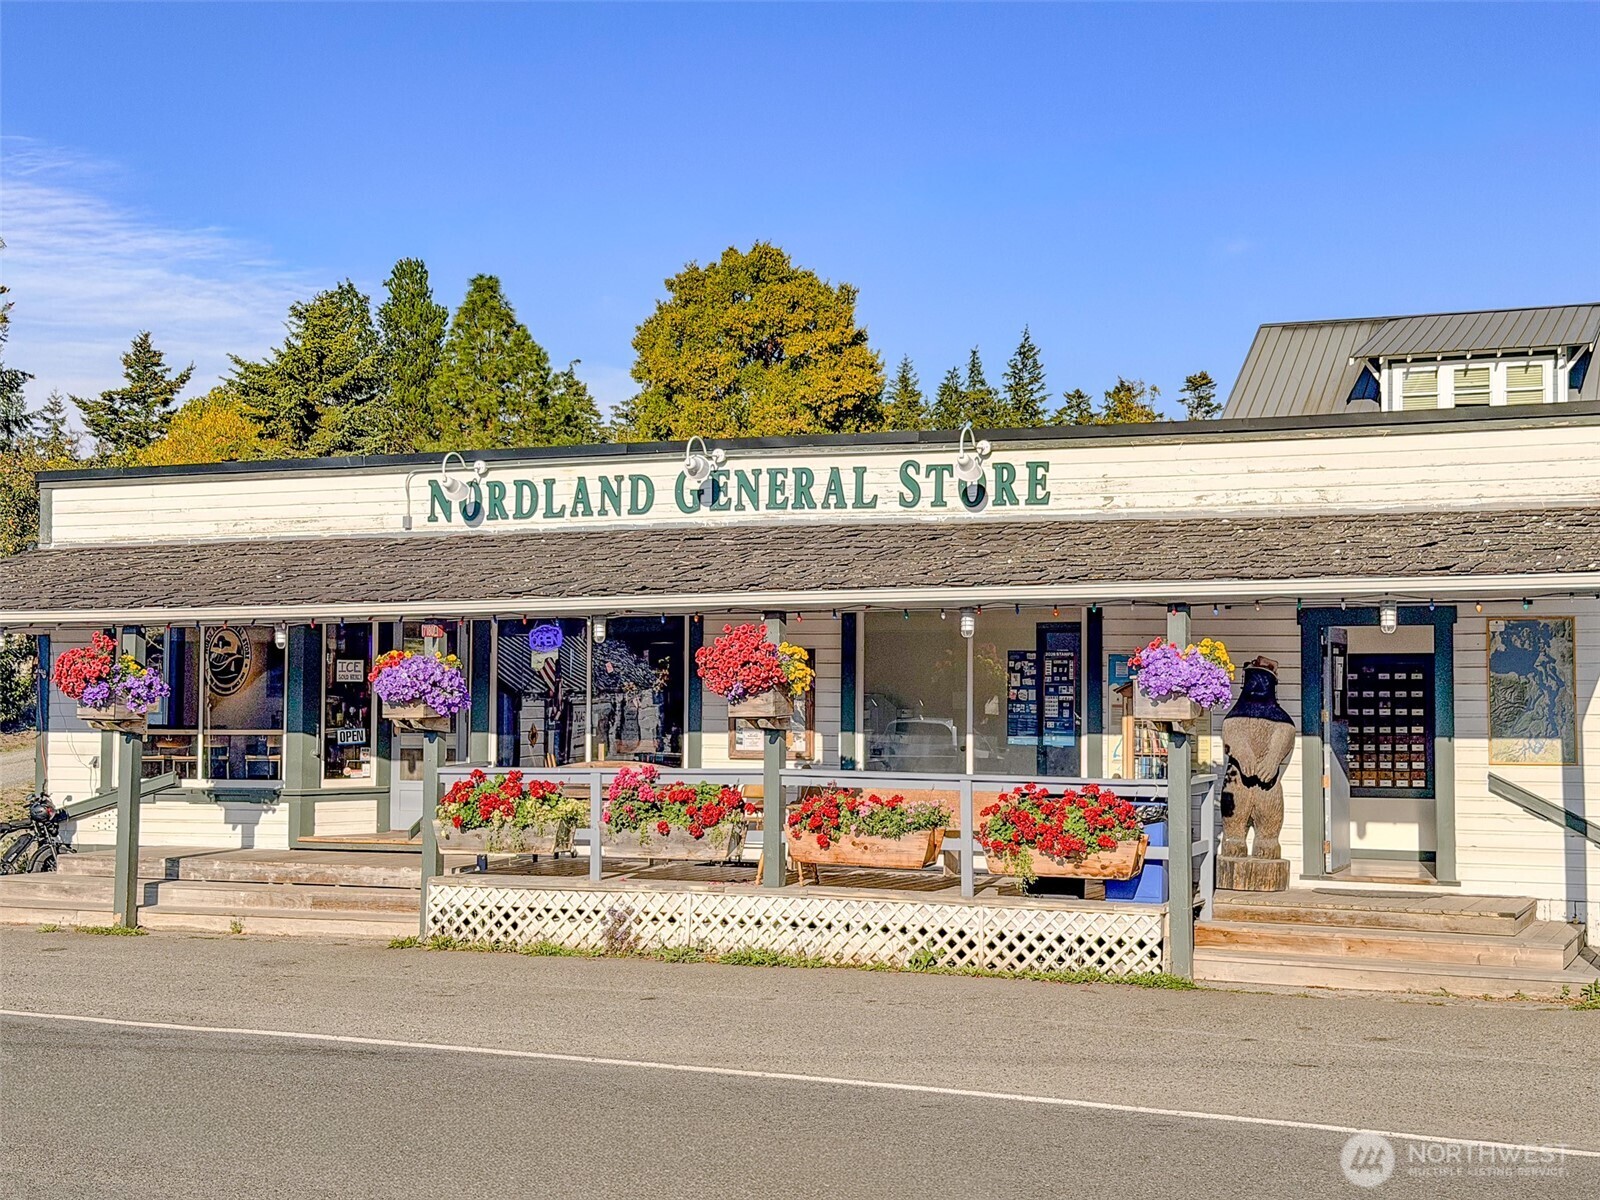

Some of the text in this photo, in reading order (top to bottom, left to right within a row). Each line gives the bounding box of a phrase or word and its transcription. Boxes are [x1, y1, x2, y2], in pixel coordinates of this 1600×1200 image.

[427, 459, 1051, 523] NORDLAND GENERAL STORE
[338, 661, 361, 673] ICE
[340, 729, 364, 743] OPEN
